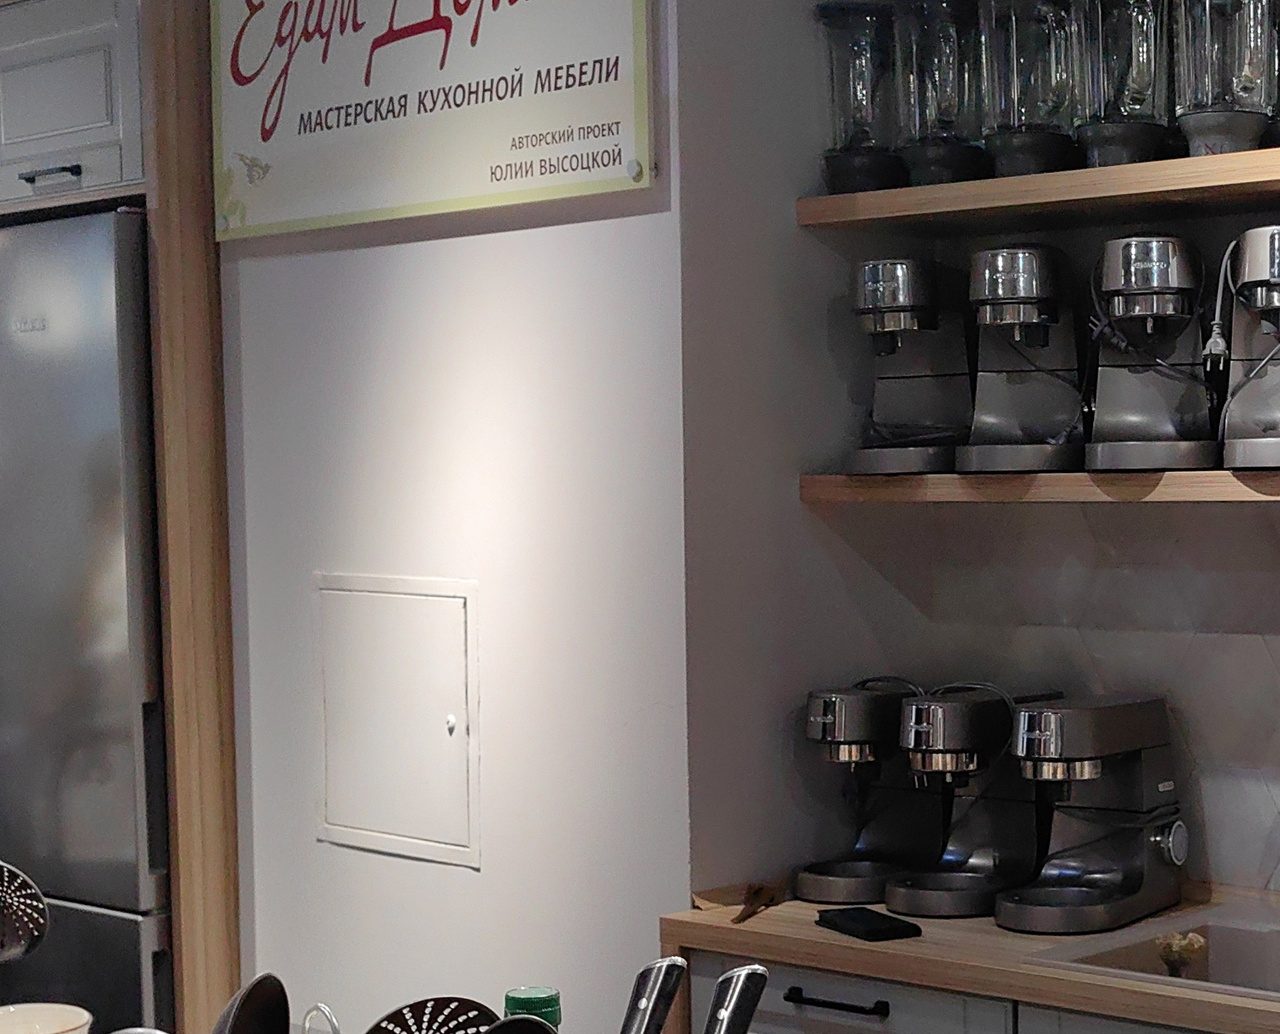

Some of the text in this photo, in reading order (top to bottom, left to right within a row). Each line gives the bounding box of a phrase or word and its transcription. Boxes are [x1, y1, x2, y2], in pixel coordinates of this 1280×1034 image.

[297, 55, 620, 135] МАСТЕРСКАЯ КУХОННОЙ МЕБЕЛИ
[510, 121, 622, 150] АВТОРСКИЙ ПРОЕКТ
[490, 143, 622, 183] ЮЛИИ ВЫСОЦКОЙ
